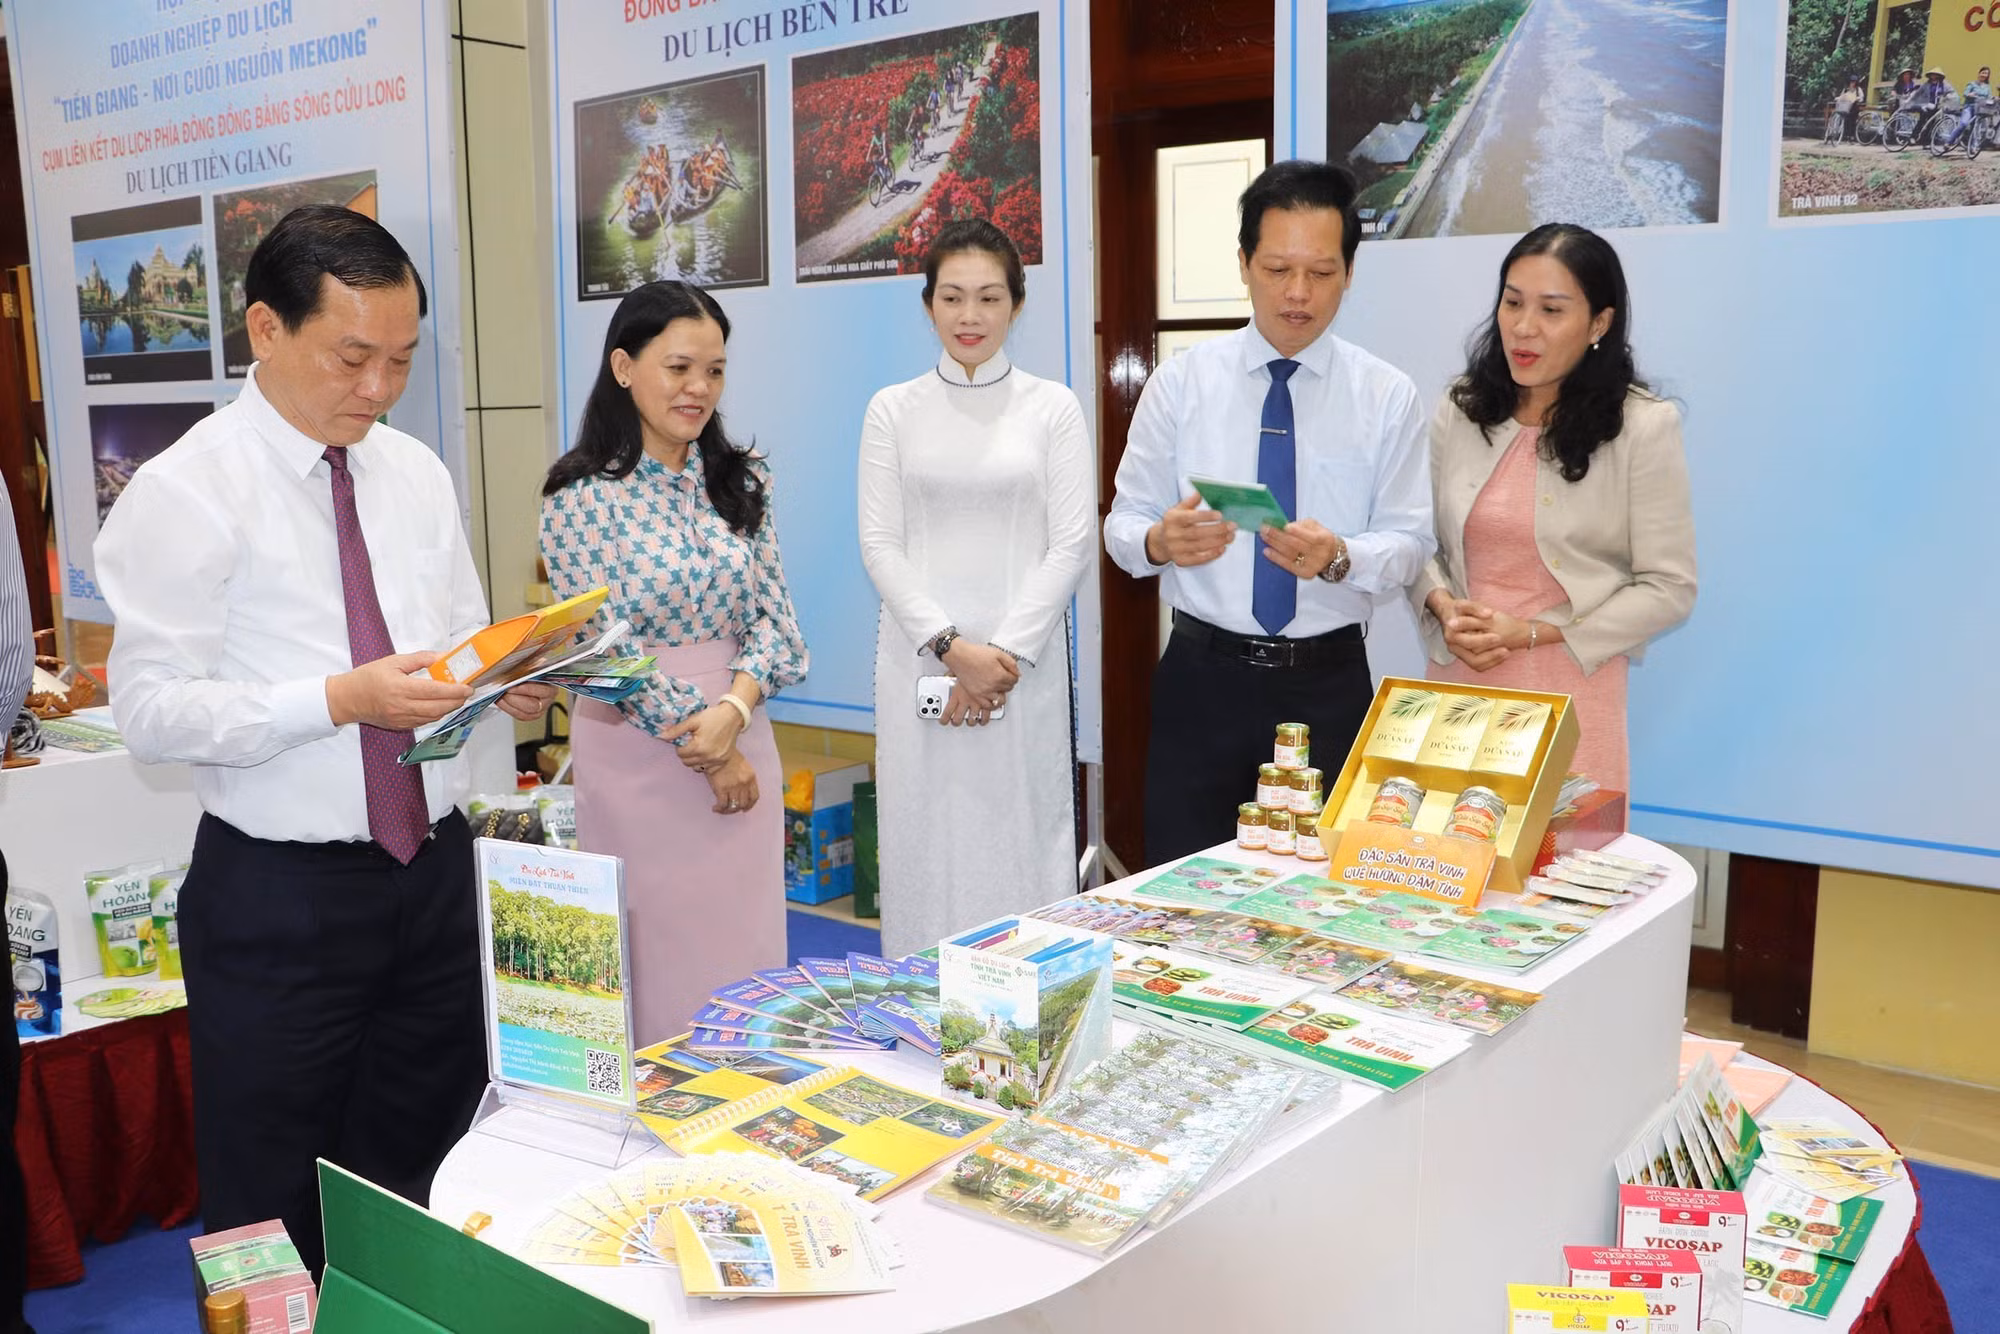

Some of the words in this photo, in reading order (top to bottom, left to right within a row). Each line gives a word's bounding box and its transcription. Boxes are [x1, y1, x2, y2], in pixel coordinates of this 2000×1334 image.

[110, 33, 160, 69] DOANH
[164, 14, 222, 55] NGHIỆP
[227, 9, 249, 39] DU
[254, 0, 293, 36] LỊCH
[663, 29, 698, 62] DU
[706, 13, 772, 57] LỊCH
[95, 83, 139, 116] GIANG
[152, 72, 179, 103] NƠI
[184, 54, 220, 95] CUỐI
[225, 41, 284, 87] NGUỒN
[42, 150, 64, 174] CỤM
[66, 138, 87, 167] LIÊN
[89, 132, 108, 161] KẾT
[111, 136, 125, 158] DU
[128, 128, 152, 159] LỊCH
[155, 118, 180, 150] PHÍA
[182, 113, 215, 144] ĐÔNG
[217, 102, 252, 137] ĐỒNG
[255, 92, 290, 130] BẰNG
[294, 89, 331, 122] SÔNG
[334, 76, 363, 114] CỬU
[366, 75, 406, 108] LONG
[126, 168, 147, 194] DU
[150, 160, 188, 194] LỊCH
[191, 148, 230, 183] TIỀN
[235, 141, 292, 176] GIANG
[1814, 193, 1841, 208] VINH
[1843, 193, 1859, 206] 02
[1358, 847, 1384, 865] ĐẶC
[1386, 849, 1411, 869] SẢN
[1413, 856, 1436, 872] TRÀ
[1438, 863, 1467, 880] VINH
[1344, 865, 1366, 880] QUÊ
[1368, 866, 1405, 884] HƯƠNG
[1406, 873, 1435, 892] ĐẬM
[1436, 880, 1464, 898] TÌNH
[992, 976, 1005, 985] NAM
[998, 967, 1012, 978] VINH
[1345, 1035, 1376, 1050] TRÀ
[1375, 1045, 1415, 1062] VINH
[789, 1240, 812, 1270] VINH
[1591, 1250, 1670, 1261] VICOSAP
[1644, 1236, 1723, 1253] VICOSAP
[1536, 1291, 1616, 1302] VICOSAP
